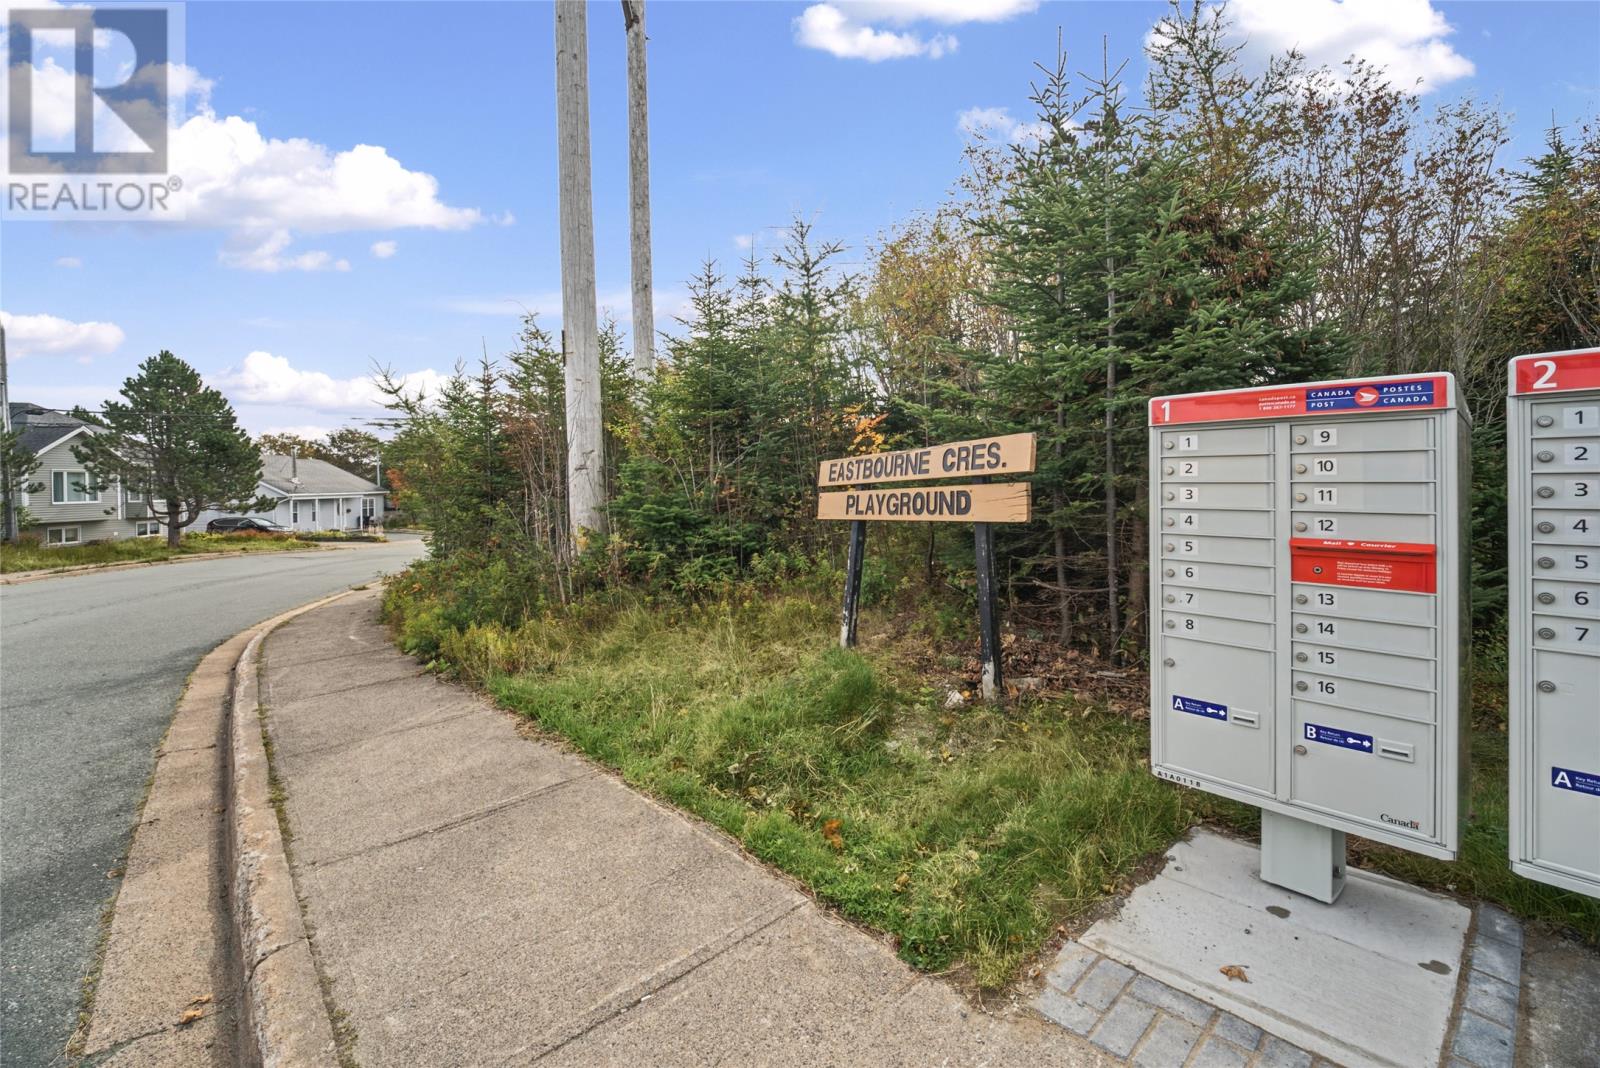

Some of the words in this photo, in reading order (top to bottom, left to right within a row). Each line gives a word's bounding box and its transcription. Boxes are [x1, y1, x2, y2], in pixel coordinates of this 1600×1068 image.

[1532, 360, 1557, 389] 2
[1311, 390, 1351, 398] CANADA
[1383, 384, 1423, 393] POSTES
[1383, 396, 1428, 404] CANADA
[1160, 401, 1170, 422] 1
[1574, 410, 1584, 425] 1
[1184, 436, 1191, 448] 1
[1319, 430, 1331, 443] 9
[1574, 446, 1588, 461] 2
[828, 450, 931, 482] EASTBOURNE
[942, 442, 1007, 472] CRES.
[1184, 462, 1193, 474] 2
[1316, 459, 1334, 472] 10
[1184, 488, 1193, 500] 3
[1317, 489, 1333, 502] 11
[1574, 482, 1588, 497] 3
[845, 490, 972, 515] PLAYGROUND
[1184, 514, 1194, 526] 4
[1317, 519, 1334, 532] 12
[1572, 518, 1589, 533] 4
[1185, 540, 1193, 552] 5
[1575, 555, 1589, 569] 5
[1185, 566, 1194, 578] 6
[1185, 593, 1194, 605] 7
[1317, 593, 1335, 606] 13
[1574, 590, 1590, 606] 6
[1185, 618, 1194, 631] 8
[1317, 622, 1335, 635] 14
[1575, 627, 1590, 642] 7
[1317, 652, 1335, 665] 15
[1317, 681, 1335, 694] 16
[1174, 698, 1184, 710] A
[1306, 726, 1316, 738] B
[1554, 771, 1572, 788] A
[1380, 813, 1420, 830] Canada
